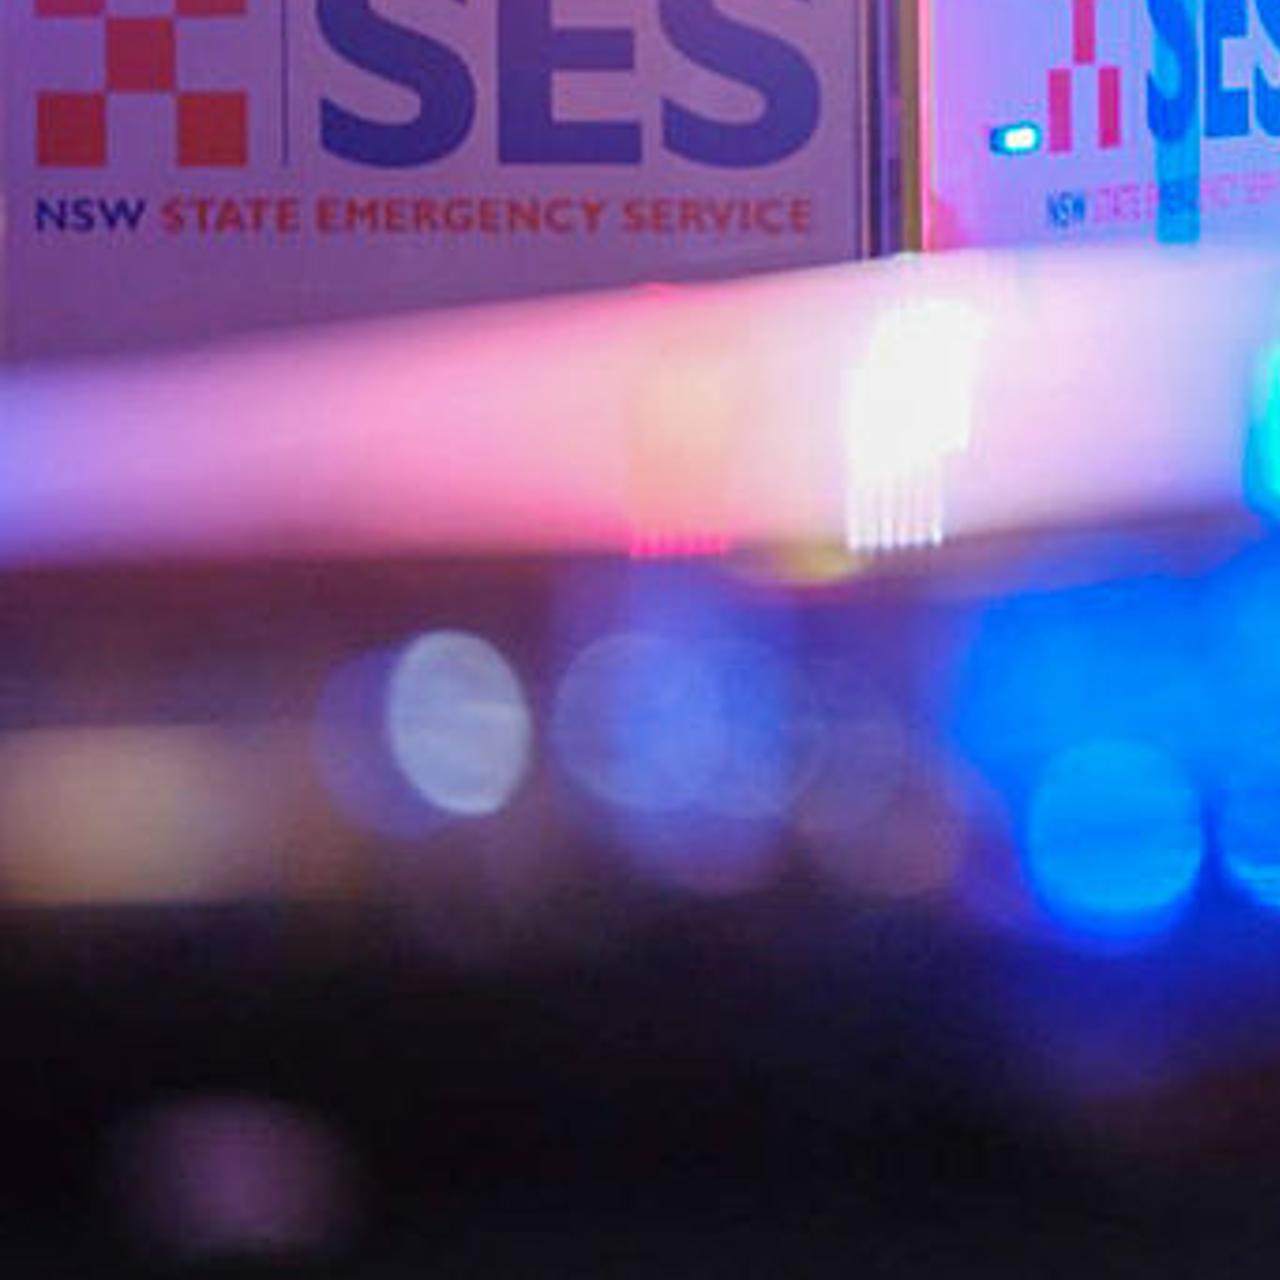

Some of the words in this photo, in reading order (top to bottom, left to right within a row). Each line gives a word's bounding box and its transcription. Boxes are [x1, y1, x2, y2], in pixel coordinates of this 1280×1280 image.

[35, 198, 147, 233] NSW
[161, 197, 300, 234] STATE
[315, 197, 606, 235] EMERGENCY
[621, 197, 813, 235] SERVICE
